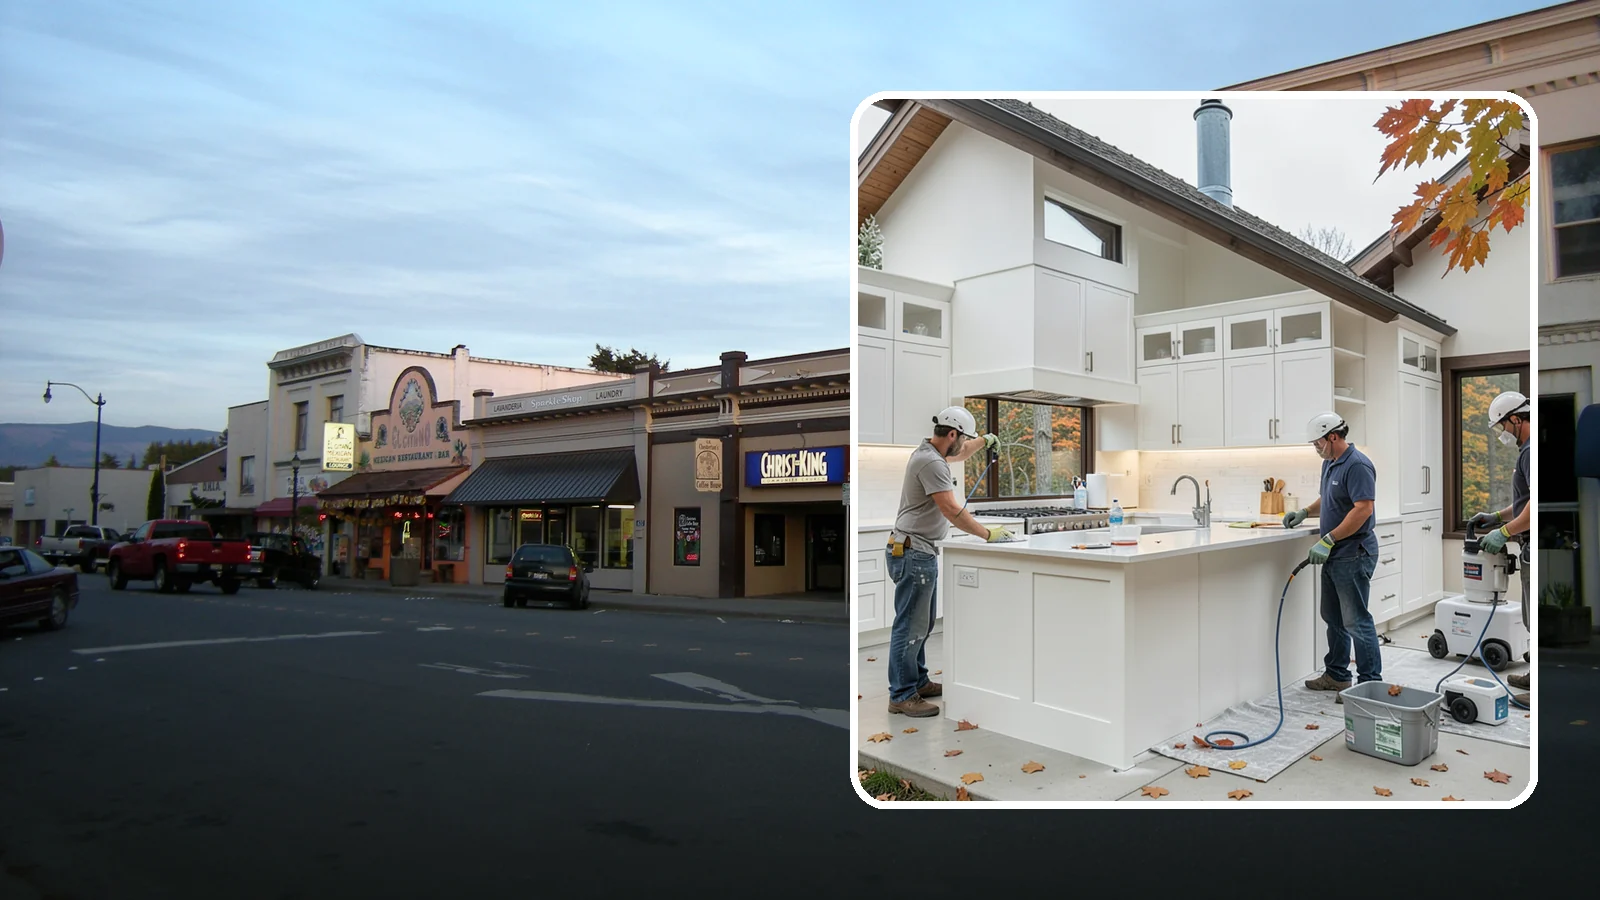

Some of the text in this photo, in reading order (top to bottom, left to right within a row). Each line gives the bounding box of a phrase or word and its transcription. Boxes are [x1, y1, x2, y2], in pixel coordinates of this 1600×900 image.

[595, 389, 623, 400] LAUNDRY
[493, 402, 522, 413] LAVANDERIA
[531, 395, 582, 409] Sparkle Shop
[392, 425, 401, 449] EL
[373, 454, 396, 464] MEXICAN
[398, 451, 434, 462] RESTAURANT
[438, 450, 450, 459] BAR
[761, 450, 827, 478] CHRIST KING
